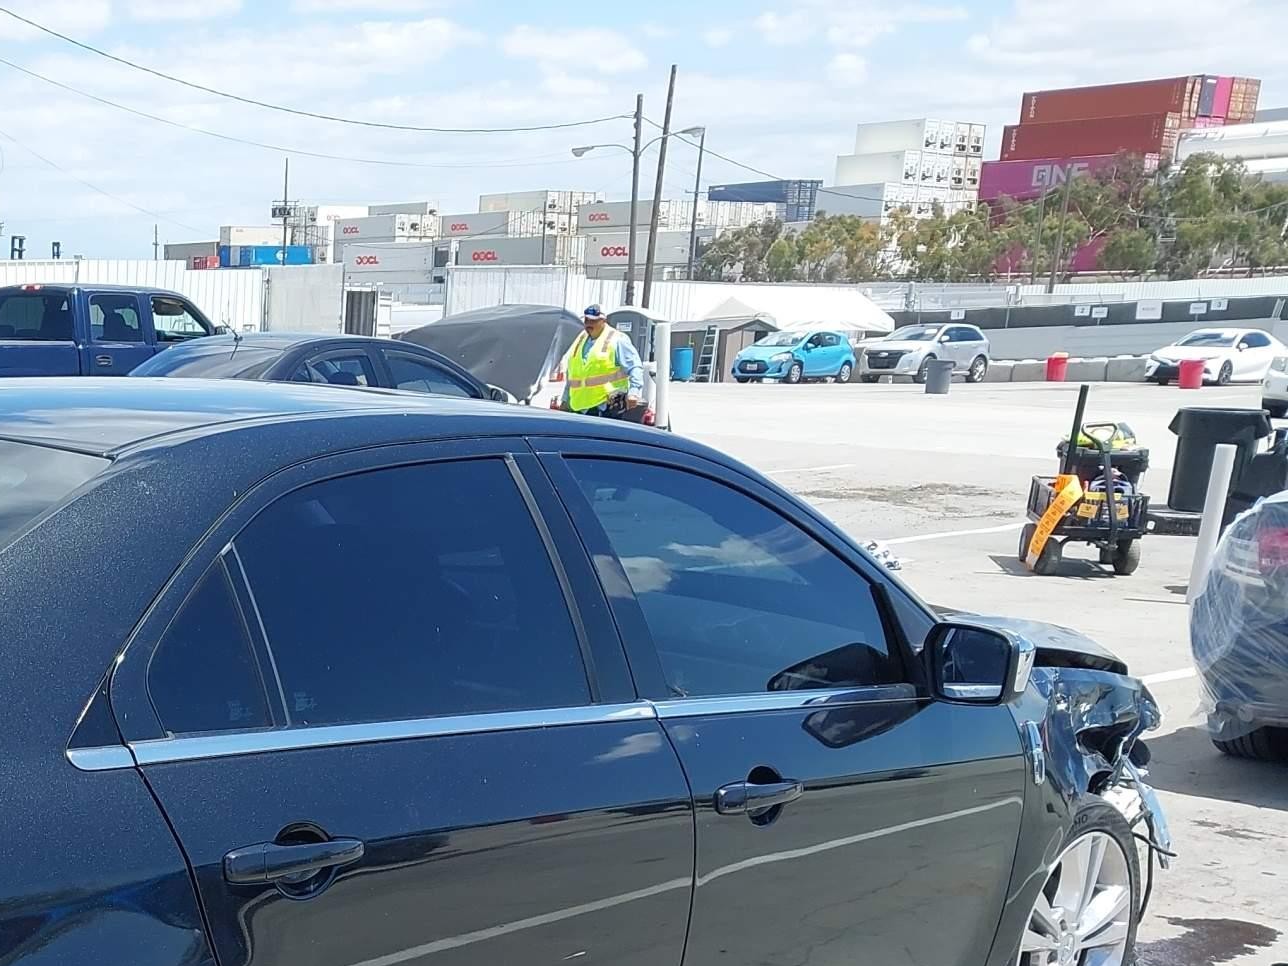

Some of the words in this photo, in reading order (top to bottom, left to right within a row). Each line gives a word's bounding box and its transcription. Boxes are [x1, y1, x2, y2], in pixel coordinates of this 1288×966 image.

[588, 212, 610, 222] OOCL
[343, 226, 360, 234] OOCL
[451, 223, 469, 231] OOCL
[472, 251, 498, 261] OOCL
[601, 246, 629, 257] OOCL
